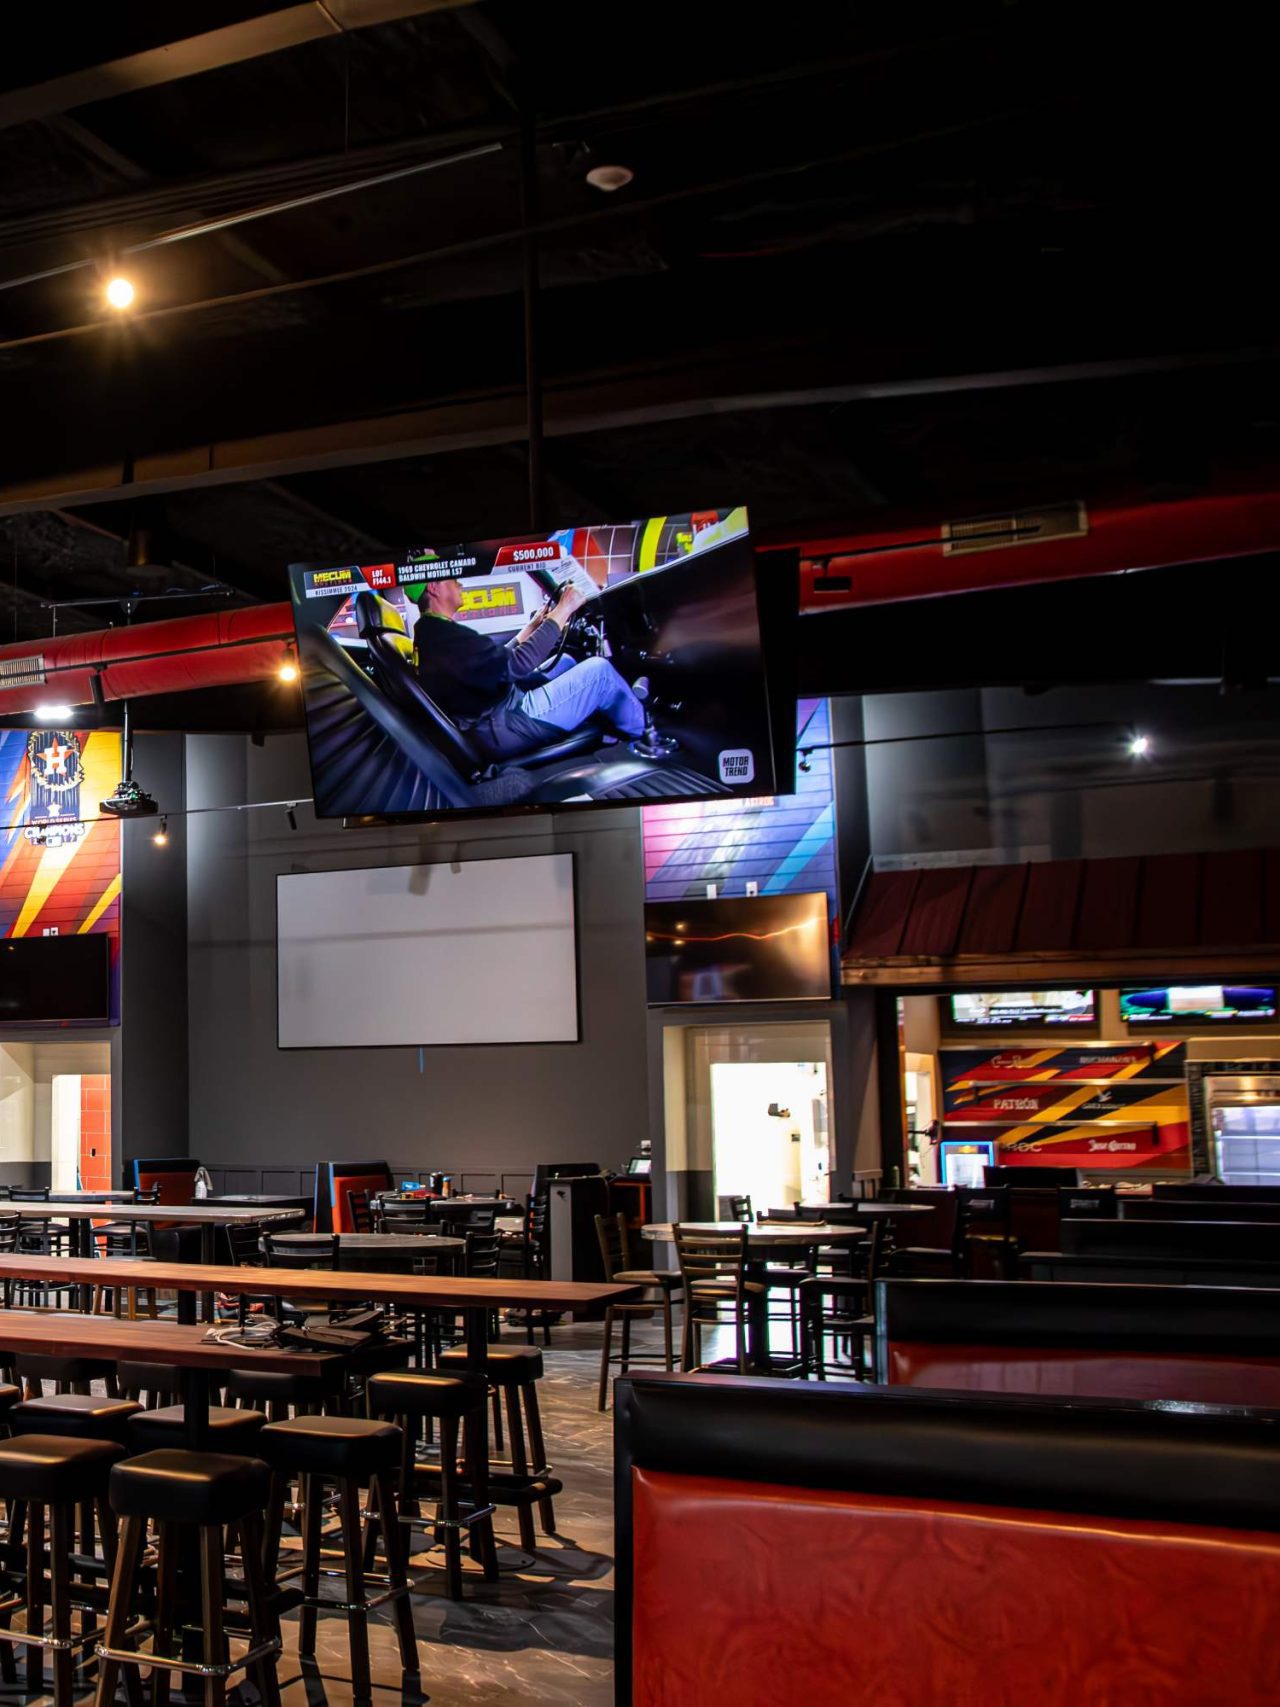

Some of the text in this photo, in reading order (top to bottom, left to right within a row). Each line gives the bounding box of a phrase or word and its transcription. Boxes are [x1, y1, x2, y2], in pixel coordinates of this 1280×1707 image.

[513, 547, 554, 562] $500,000
[398, 557, 477, 575] 1969 CHEVROLET CAMARO
[313, 569, 352, 584] MECUM
[371, 569, 384, 578] LOT
[398, 573, 426, 583] BALDWIN
[427, 569, 451, 580] MOTION
[458, 586, 517, 613] ECUM
[723, 755, 749, 768] MOTOR
[725, 766, 748, 777] TREND
